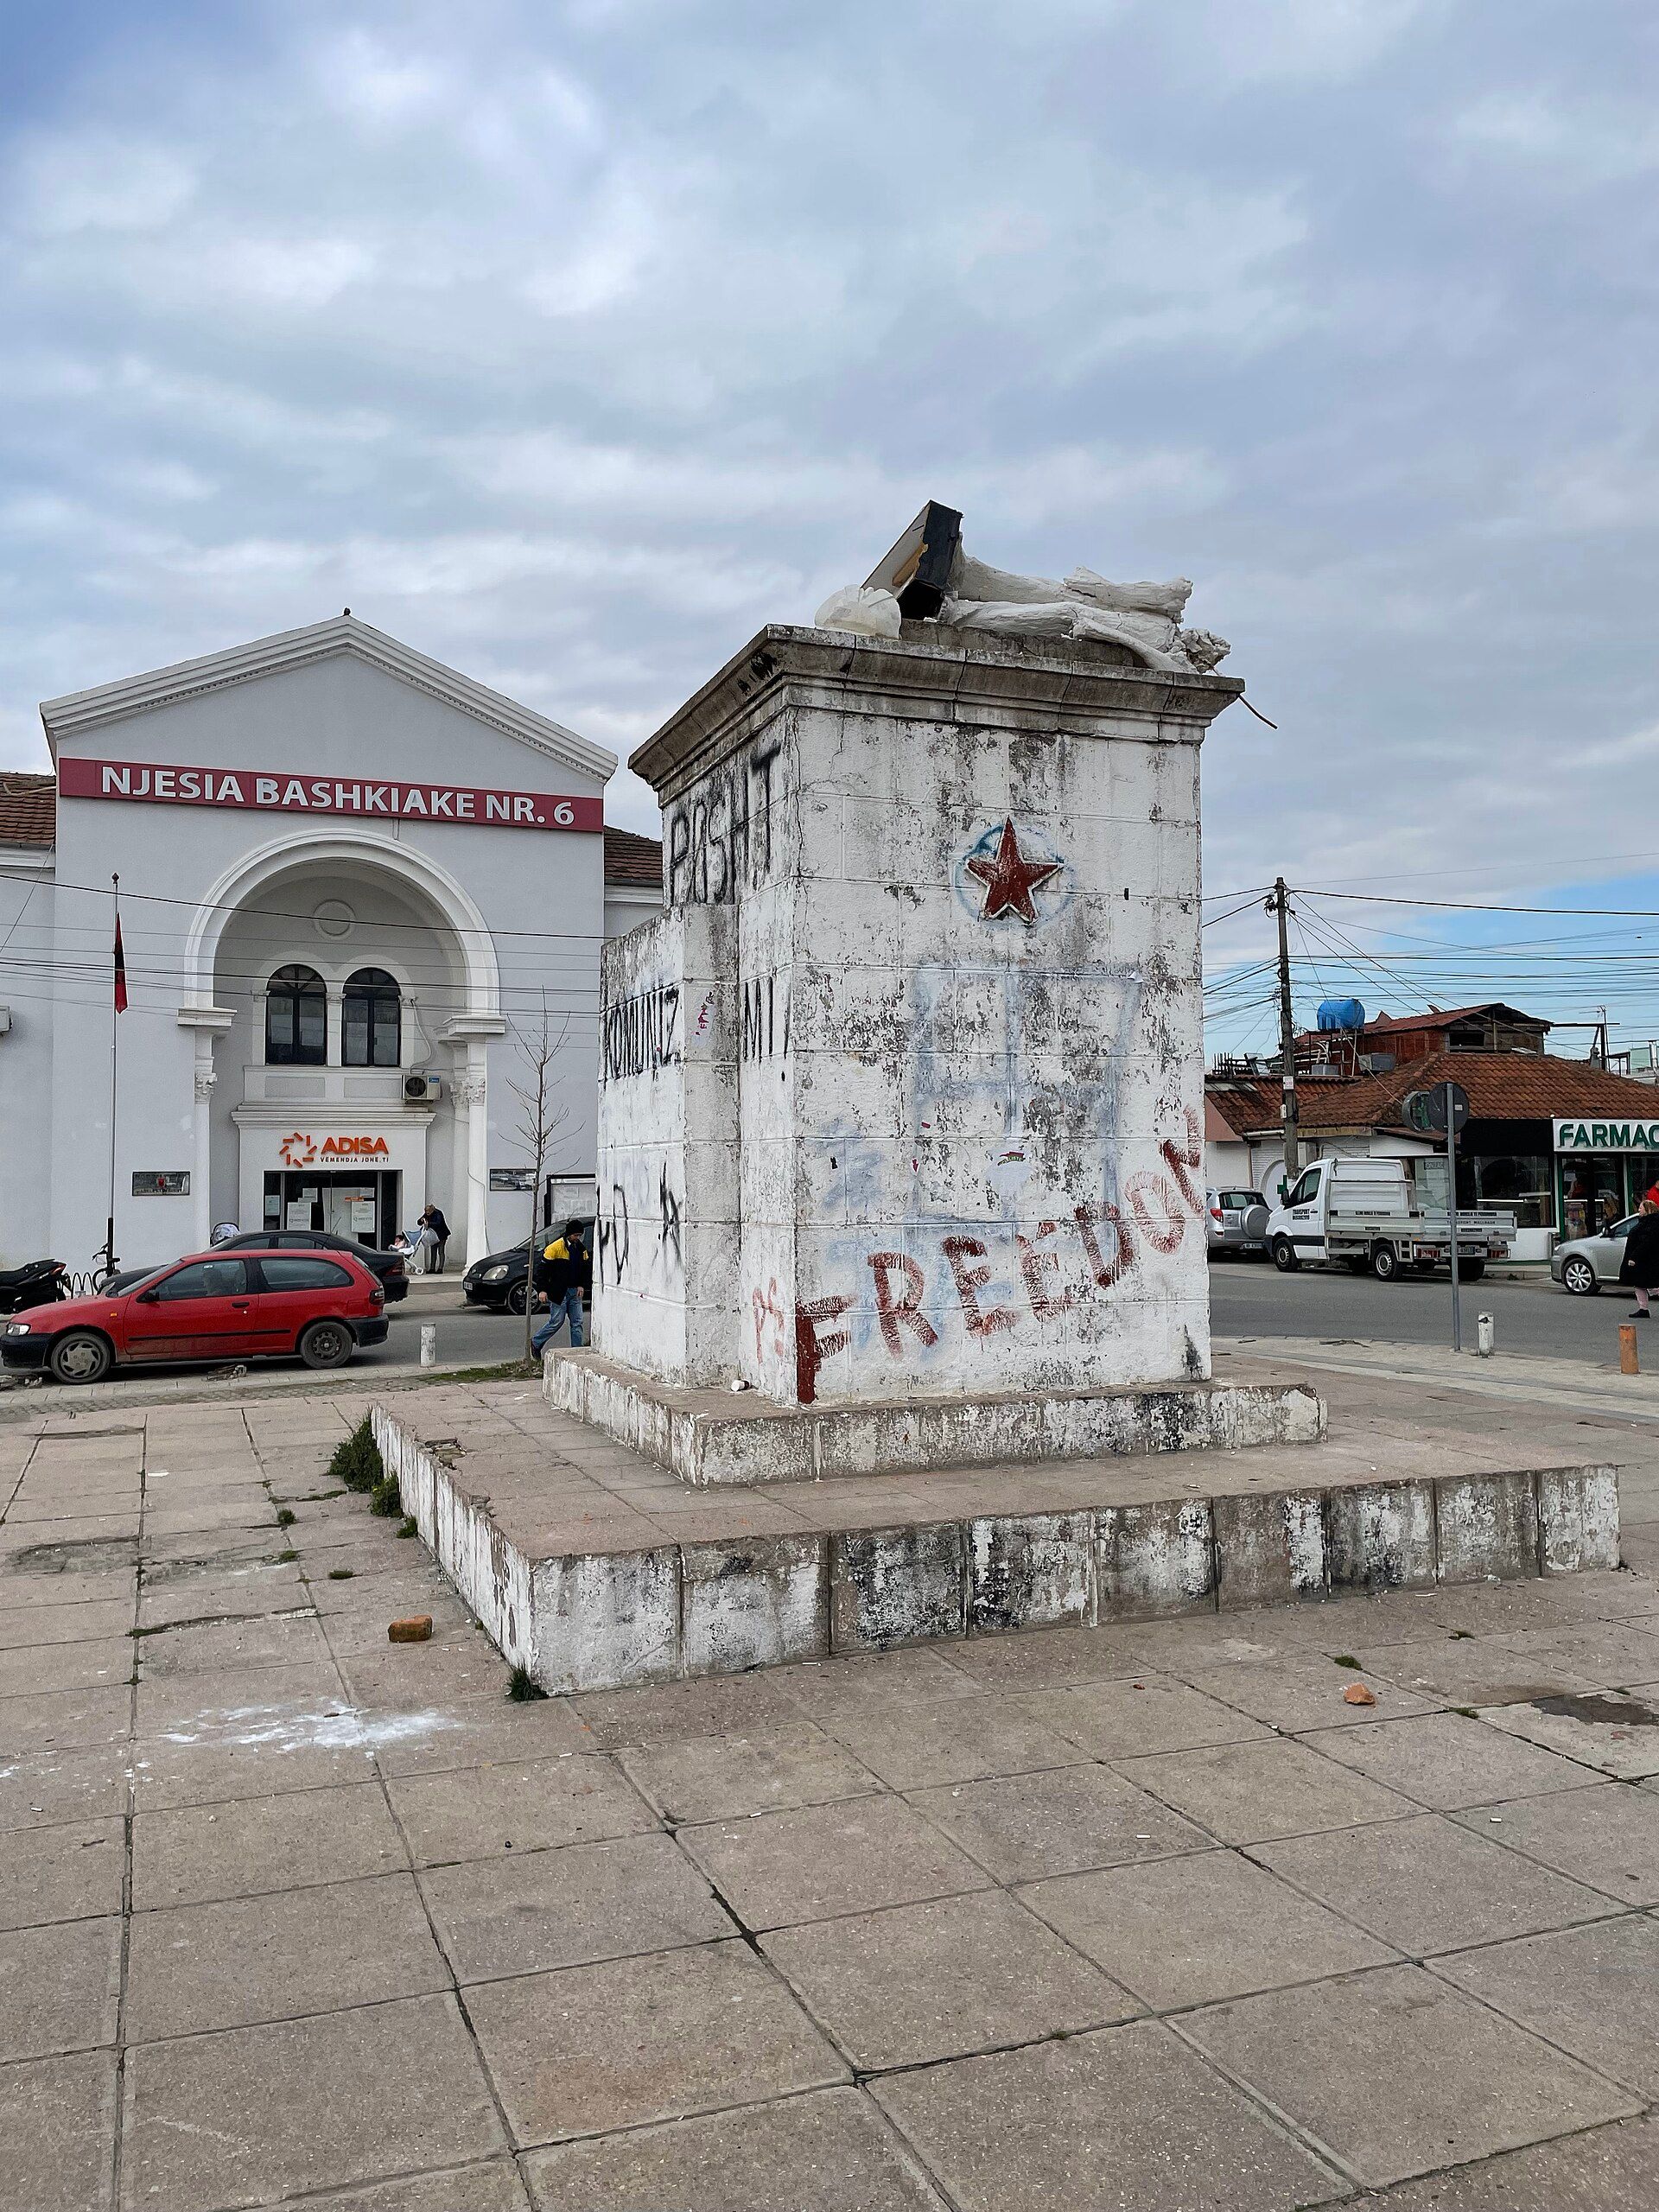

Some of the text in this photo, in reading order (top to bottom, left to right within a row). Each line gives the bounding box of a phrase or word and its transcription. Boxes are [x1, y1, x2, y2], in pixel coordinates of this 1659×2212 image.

[102, 766, 574, 825] NJESIA BASHKIAKE NR. 6
[321, 1137, 389, 1154] ADISA
